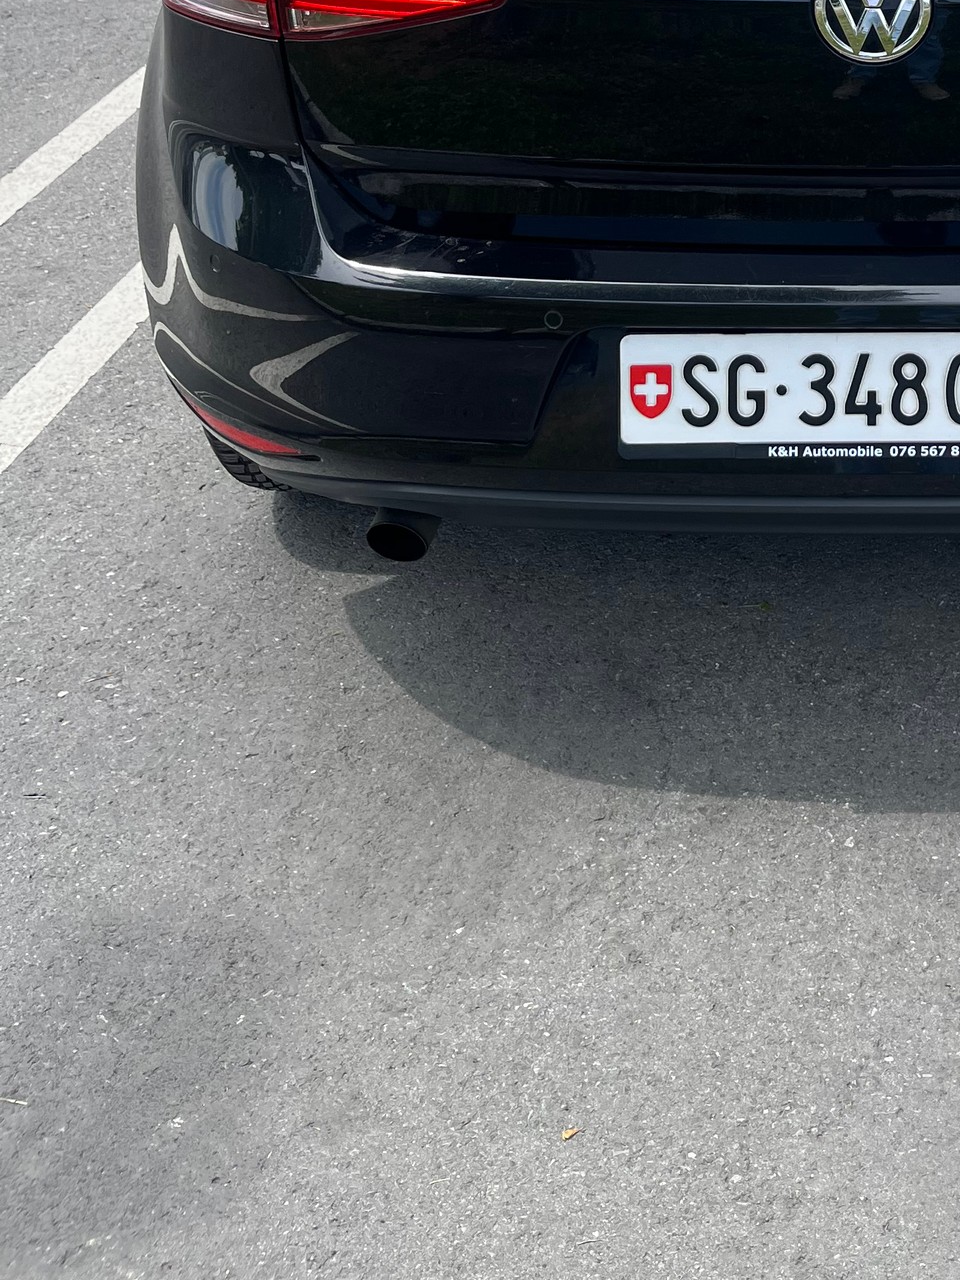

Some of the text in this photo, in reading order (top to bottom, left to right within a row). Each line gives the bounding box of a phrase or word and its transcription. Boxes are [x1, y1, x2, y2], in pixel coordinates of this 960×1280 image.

[767, 445, 799, 458] K&H
[802, 445, 883, 458] Automobile
[889, 445, 917, 457] 076
[920, 445, 947, 457] 567
